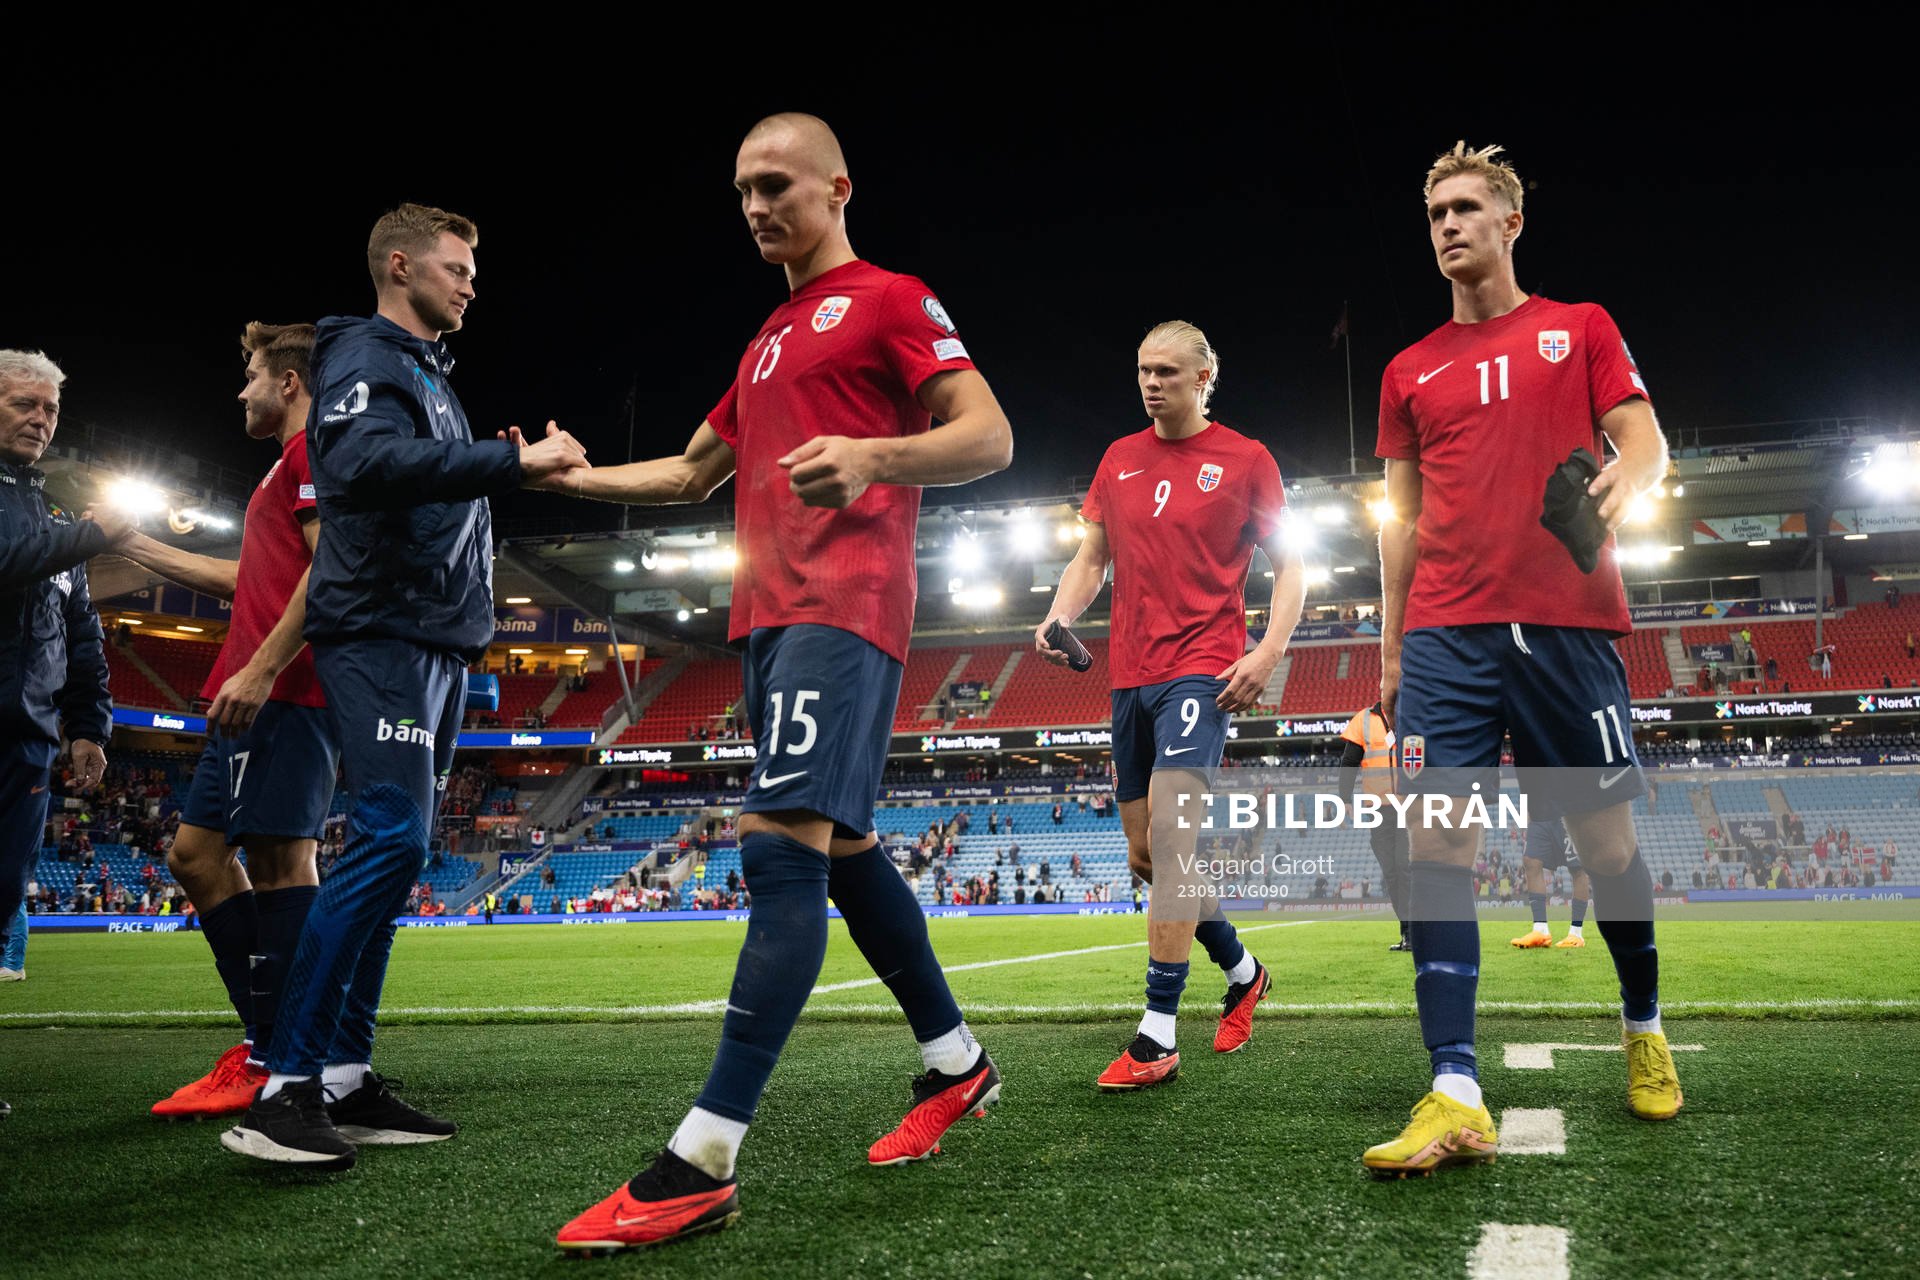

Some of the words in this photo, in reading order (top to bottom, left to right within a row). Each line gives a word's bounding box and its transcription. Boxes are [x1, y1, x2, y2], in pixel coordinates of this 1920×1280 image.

[1476, 354, 1509, 405] 11
[1153, 480, 1171, 517] 9
[1735, 702, 1768, 715] Norsk
[1768, 700, 1812, 715] Tipping
[1878, 697, 1912, 709] Norsk
[1180, 698, 1200, 737] 9
[1630, 707, 1671, 720] Tipping
[769, 690, 820, 755] 15
[1294, 722, 1324, 733] Norsk
[1052, 733, 1081, 744] Norsk
[1592, 704, 1629, 763] 11
[936, 738, 965, 749] Norsk
[965, 736, 1000, 750] Tipping
[108, 922, 143, 933] PEACE
